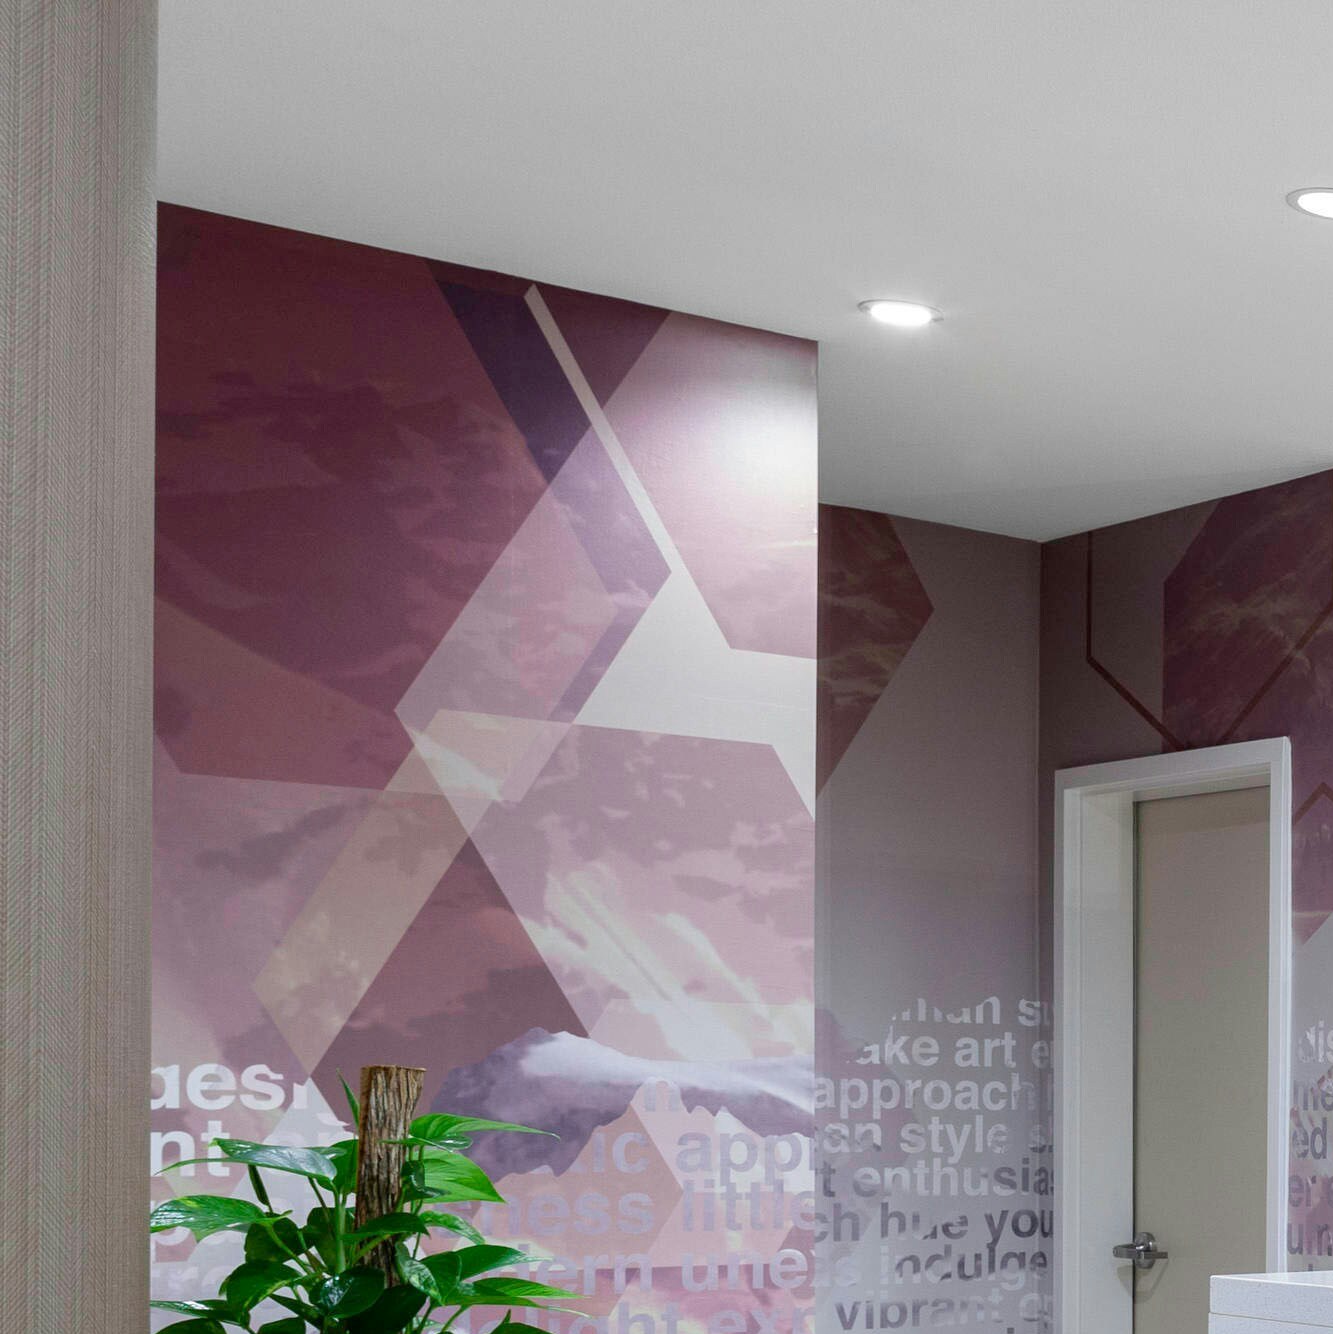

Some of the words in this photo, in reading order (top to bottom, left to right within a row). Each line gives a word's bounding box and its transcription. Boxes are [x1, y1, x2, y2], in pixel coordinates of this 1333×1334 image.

[954, 1031, 1017, 1068] art
[900, 1114, 1009, 1165] style
[852, 1156, 1054, 1199] enthusia
